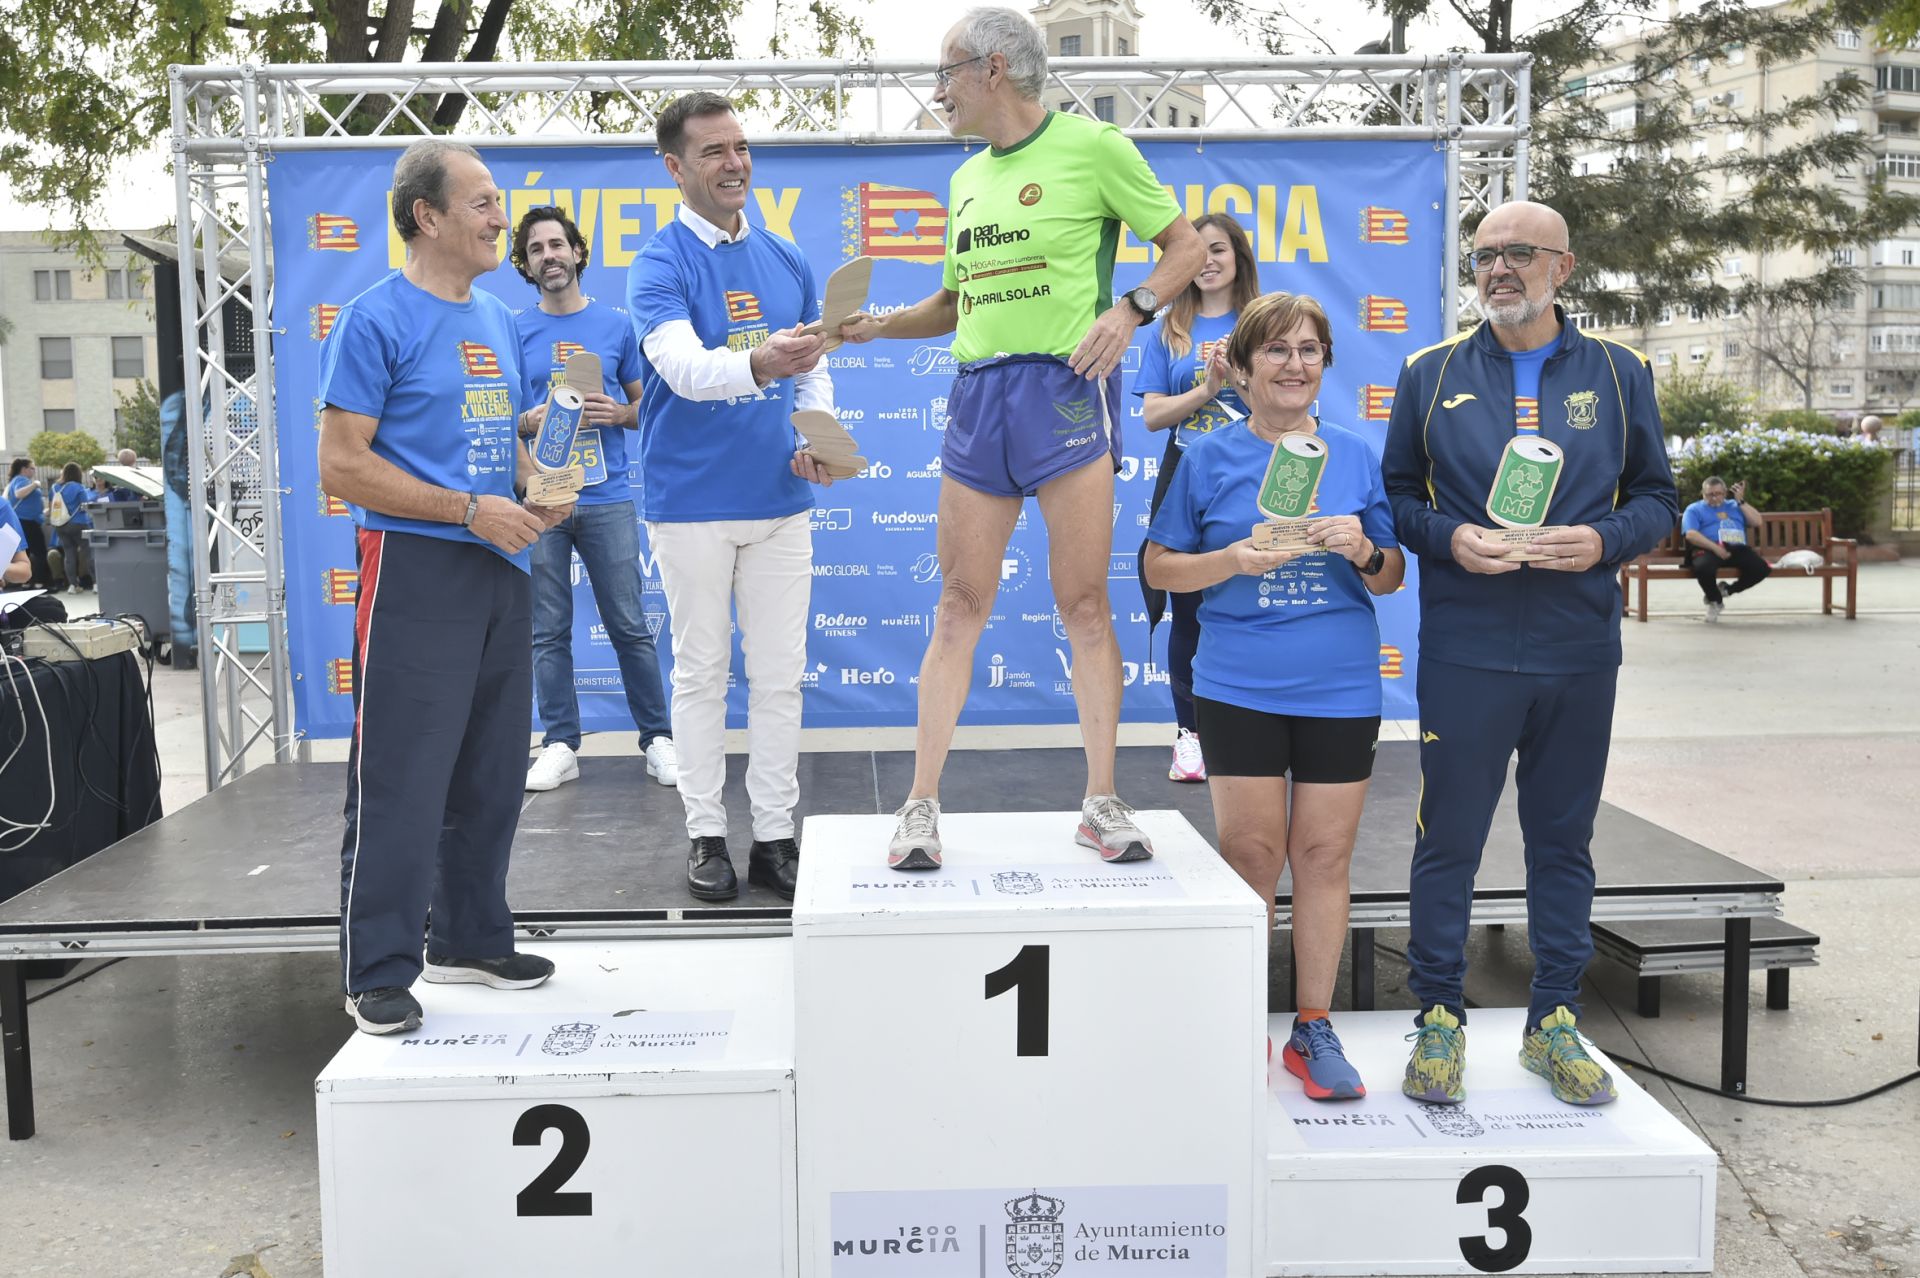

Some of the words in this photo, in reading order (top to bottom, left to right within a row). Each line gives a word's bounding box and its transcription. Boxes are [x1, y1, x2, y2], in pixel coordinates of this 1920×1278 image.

[974, 224, 999, 242] pan
[976, 229, 1030, 249] moreno
[970, 284, 1051, 307] CARRILSOLAR
[830, 357, 868, 369] GLOBAL
[460, 404, 469, 419] X
[834, 406, 864, 420] lero
[878, 412, 919, 420] MURCIA
[575, 439, 598, 447] ALENCIA
[1144, 458, 1158, 468] El
[852, 461, 892, 479] ero
[906, 471, 931, 479] AGUAS
[809, 508, 827, 517] re
[872, 511, 939, 525] fundown
[810, 521, 838, 531] ero
[834, 564, 871, 576] GLOBAL
[1113, 562, 1132, 570] LOLI
[814, 613, 868, 629] Bolero
[881, 618, 921, 626] MURCIA
[1022, 613, 1051, 622] Región
[1130, 612, 1148, 623] LA
[825, 629, 857, 637] FITNESS
[573, 676, 622, 686] LORISTERÍA
[840, 667, 895, 685] Hero
[1005, 671, 1031, 680] Jamón
[1008, 680, 1036, 688] Jamón
[852, 879, 957, 889] MURCIA
[1050, 874, 1175, 884] Ayuntamiento
[1079, 881, 1149, 889] Murcia
[984, 944, 1050, 1057] 1
[401, 1037, 506, 1046] MURCIA
[604, 1030, 729, 1041] Ayuntamiento
[600, 1039, 623, 1048] de
[628, 1039, 697, 1048] Murcia
[1293, 1117, 1396, 1127] MURCIA
[1484, 1110, 1604, 1123] Ayuntamiento
[1490, 1121, 1513, 1130] de
[1518, 1119, 1585, 1130] Murcia
[512, 1103, 592, 1217] 2
[1455, 1164, 1532, 1273] 3
[899, 1225, 958, 1237] 1200
[832, 1236, 961, 1257] MURCIA
[1073, 1221, 1226, 1242] Ayuntamiento
[1074, 1244, 1100, 1261] de
[1106, 1242, 1191, 1261] Murcia
